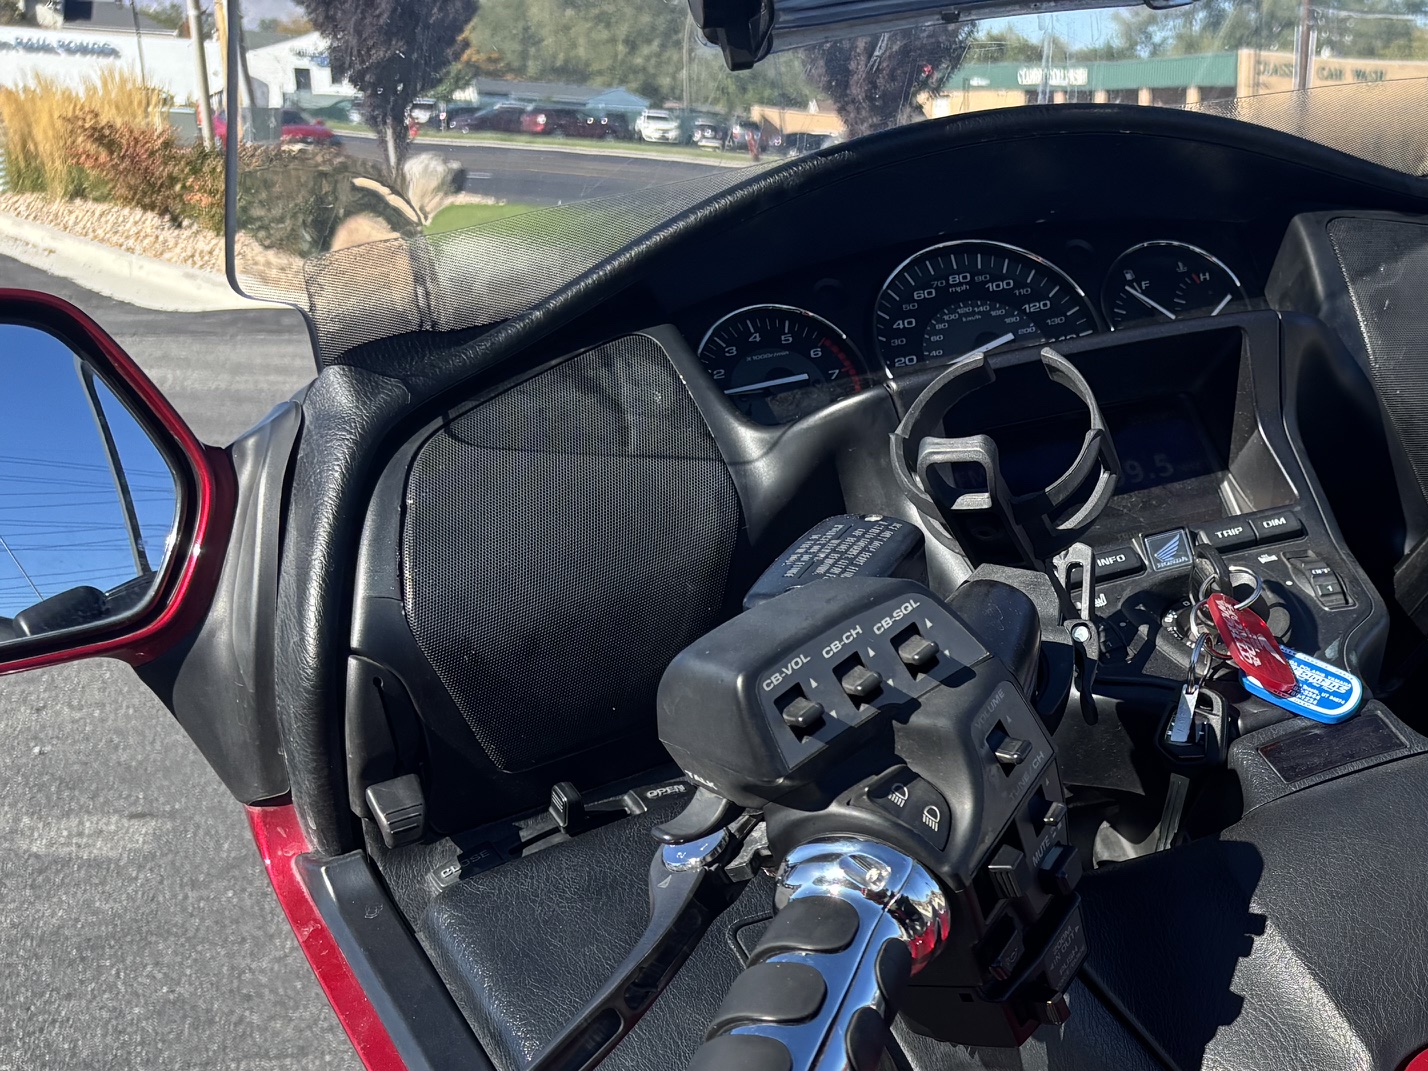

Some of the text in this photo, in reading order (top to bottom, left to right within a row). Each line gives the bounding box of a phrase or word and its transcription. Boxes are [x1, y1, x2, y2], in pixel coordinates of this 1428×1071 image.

[949, 273, 970, 284] 80
[1200, 272, 1210, 281] H
[931, 280, 946, 288] 70
[949, 284, 969, 293] mph
[985, 279, 1014, 292] 100
[1141, 280, 1150, 290] F
[913, 288, 936, 300] 60
[1013, 288, 1031, 296] 110
[902, 303, 918, 311] 50
[1021, 300, 1051, 313] 120
[893, 318, 916, 329] 40
[1046, 316, 1065, 326] 130
[749, 333, 761, 342] 4
[781, 334, 793, 344] 5
[890, 338, 906, 346] 30
[725, 346, 737, 356] 3
[810, 348, 822, 358] 6
[894, 355, 917, 367] 20
[713, 369, 726, 379] 2
[828, 370, 840, 379] 7
[1117, 452, 1175, 487] 9.5
[1262, 517, 1287, 528] DIM
[1215, 526, 1243, 539] TRIP
[1097, 554, 1126, 567] INFO
[1157, 556, 1188, 568] HONDA
[873, 599, 920, 635] CB-SQL
[822, 624, 863, 659] CB-CH
[762, 654, 811, 692] CB-VOL
[975, 689, 1005, 729] VOLUME
[646, 784, 687, 799] OPEN
[1032, 835, 1050, 868] MUTE
[441, 849, 490, 878] CLOSE
